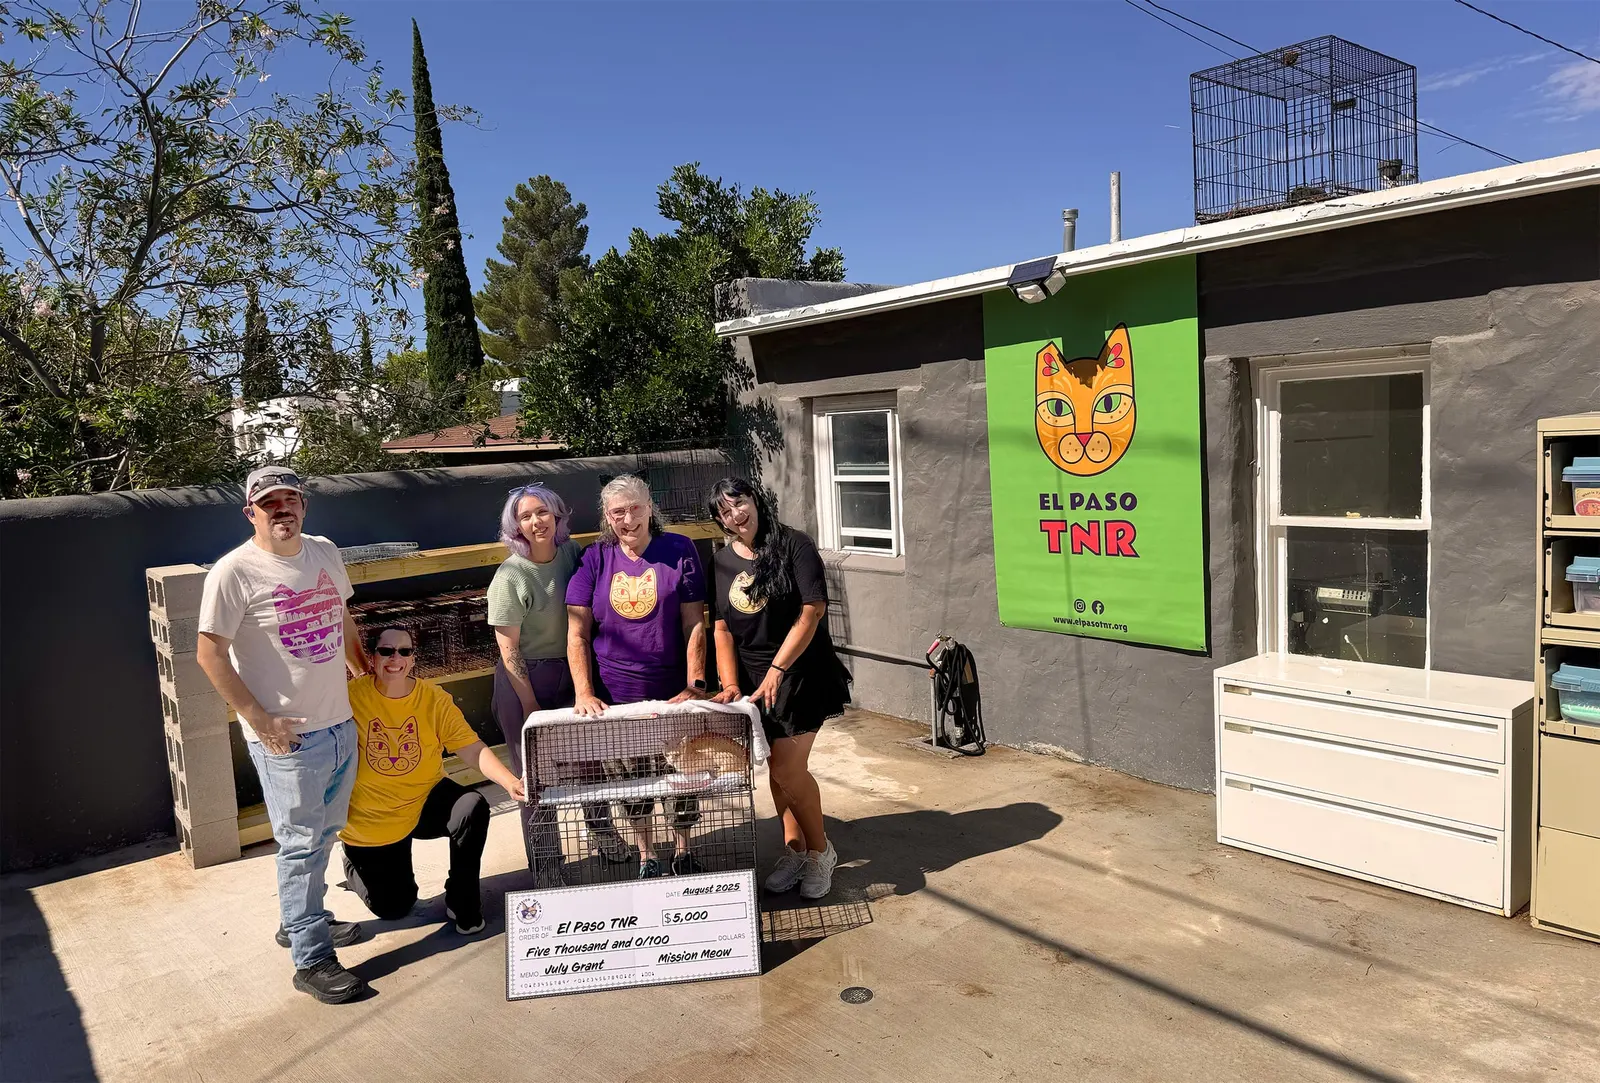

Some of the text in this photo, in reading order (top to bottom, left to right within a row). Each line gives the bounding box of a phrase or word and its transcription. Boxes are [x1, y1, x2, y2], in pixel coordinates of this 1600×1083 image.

[1039, 492, 1138, 512] EL PASO
[1039, 519, 1140, 558] TNR
[1053, 617, 1128, 632] www.elpasotnr.org
[665, 882, 740, 899] DATE August 2025
[556, 915, 639, 935] El Paso TNR
[664, 910, 708, 924] $5,000
[718, 932, 746, 942] DOLLARS
[526, 934, 670, 958] Five Thousand and 0/100
[657, 948, 732, 964] Mission Meow
[520, 970, 540, 978] MEMO
[544, 959, 605, 976] July Grant
